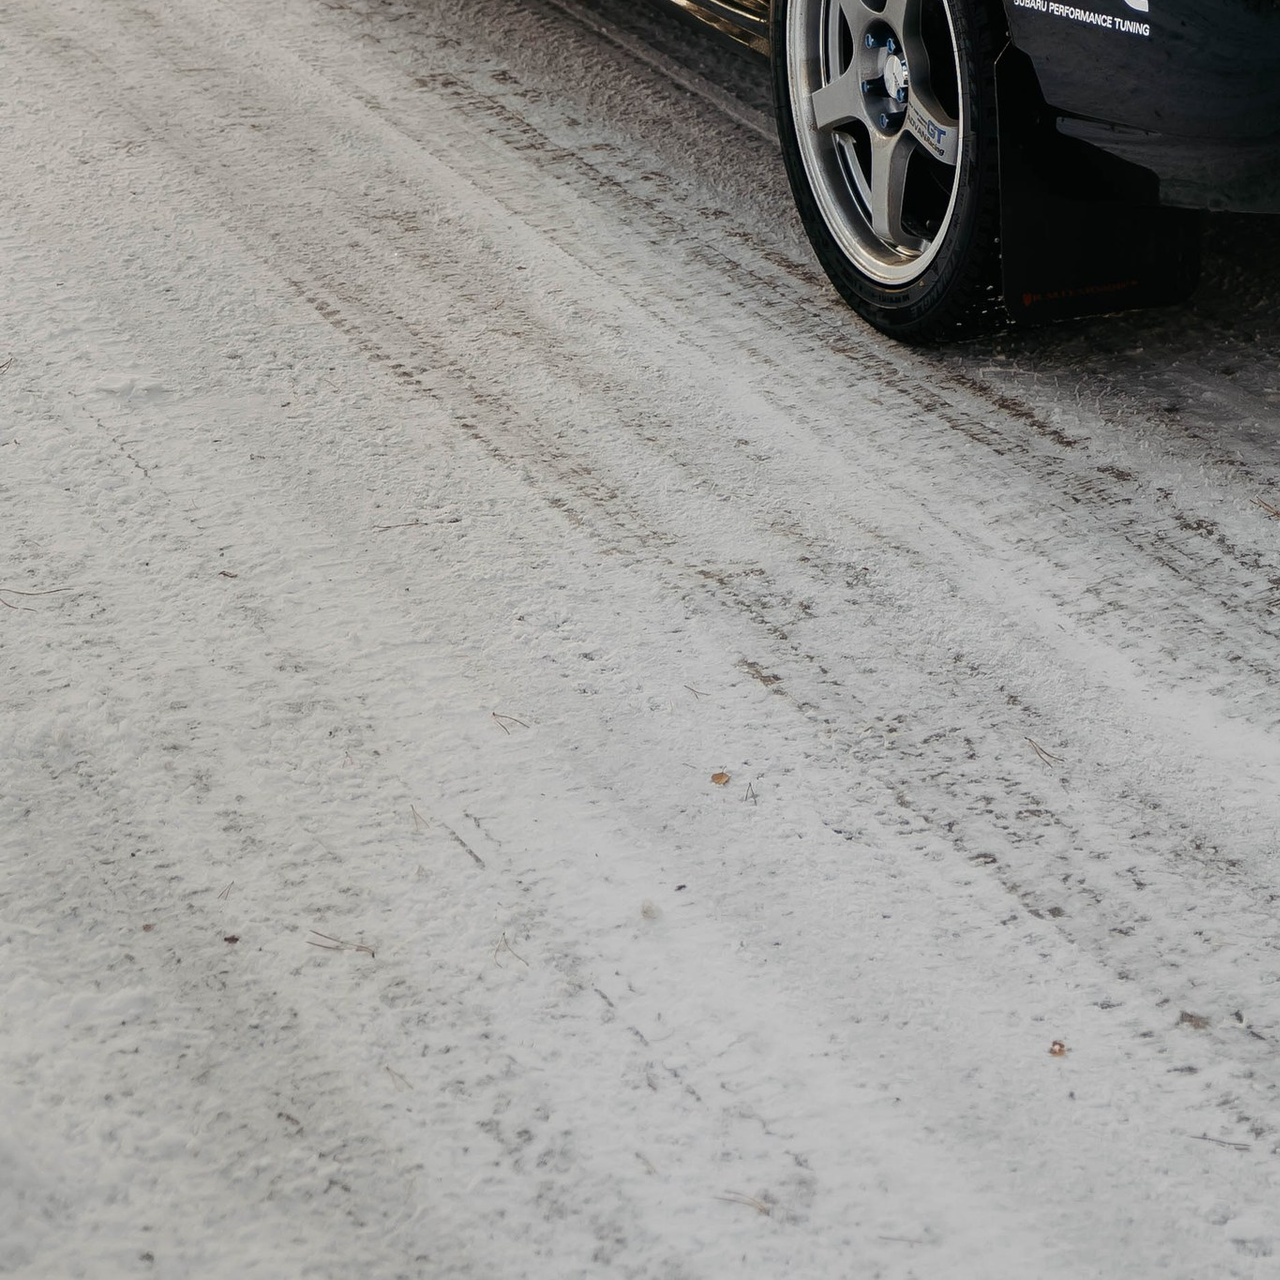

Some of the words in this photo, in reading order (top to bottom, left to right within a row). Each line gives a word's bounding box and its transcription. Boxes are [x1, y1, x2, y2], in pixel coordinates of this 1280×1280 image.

[1048, 2, 1113, 28] PERFORMANCE
[1113, 17, 1150, 37] TUNING
[927, 119, 947, 145] GT
